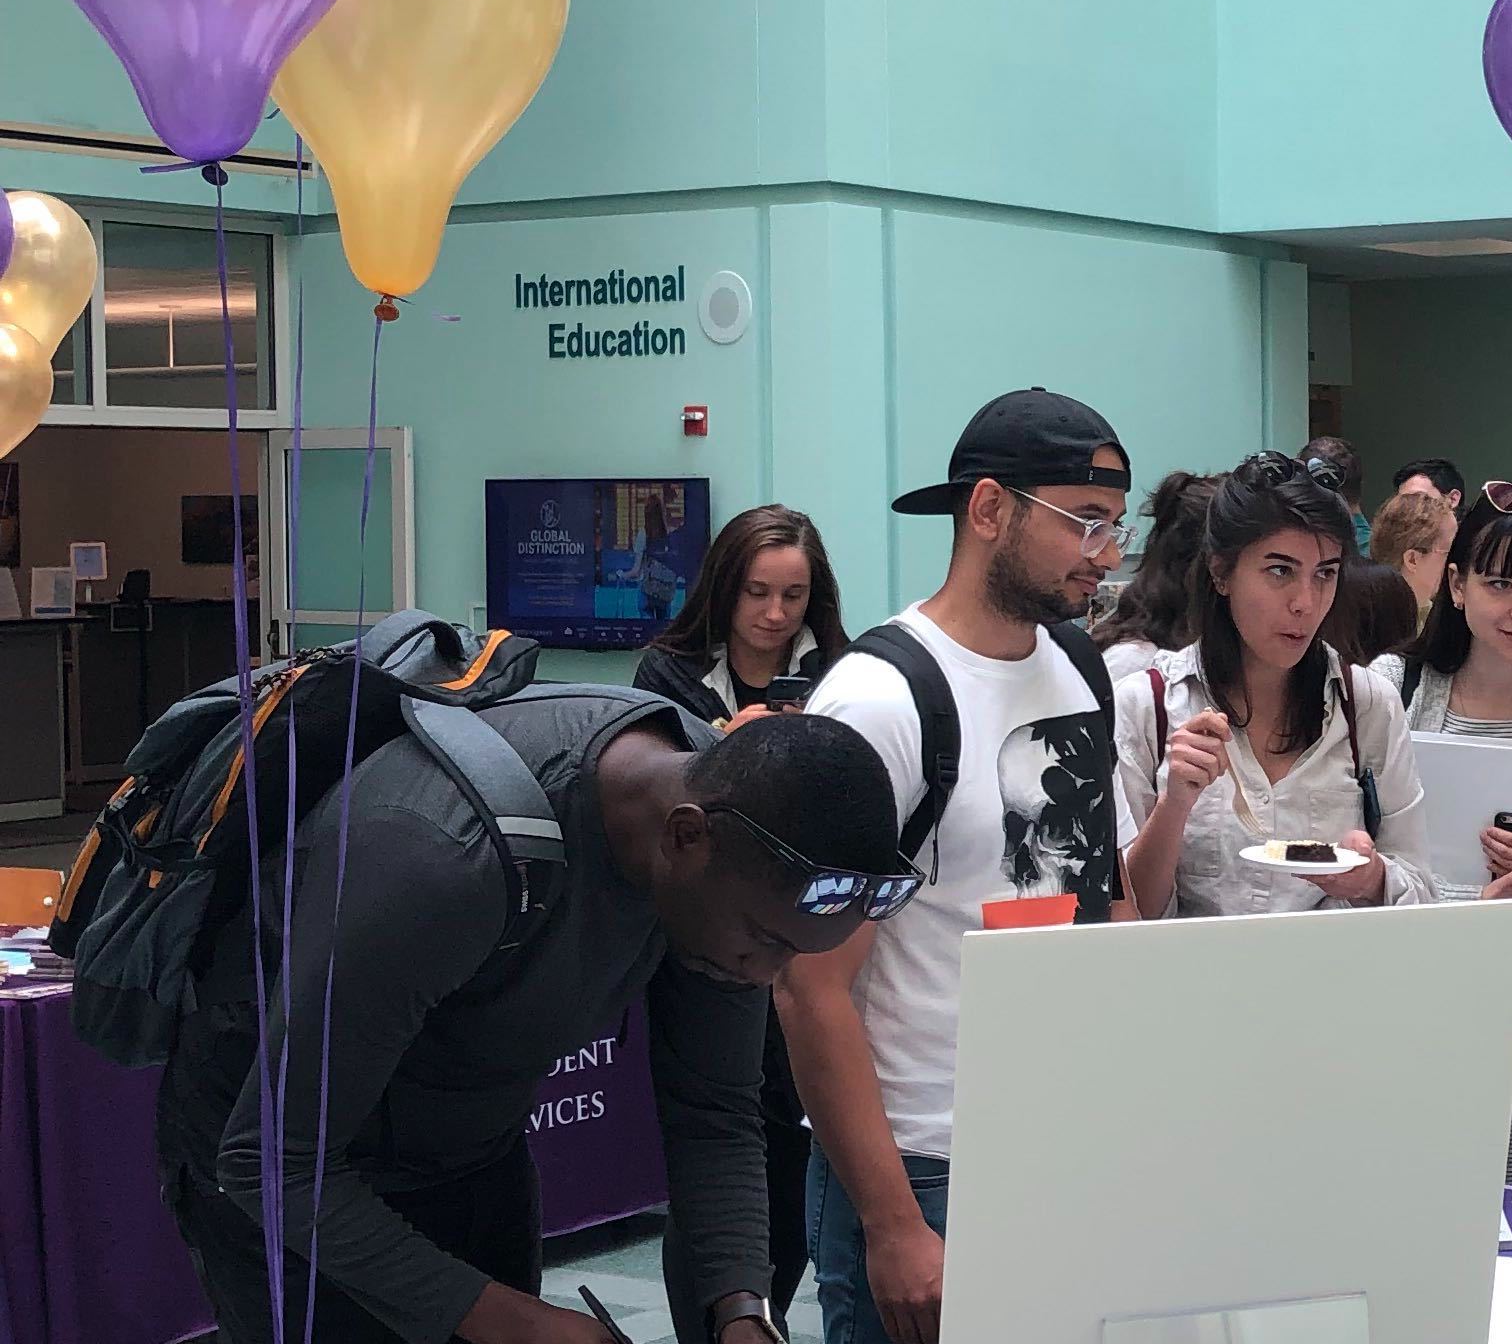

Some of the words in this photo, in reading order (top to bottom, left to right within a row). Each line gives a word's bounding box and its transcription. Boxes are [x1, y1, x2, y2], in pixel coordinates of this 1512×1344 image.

[514, 264, 685, 308] International
[548, 320, 686, 358] Education
[530, 529, 571, 542] GLOBAL
[517, 542, 585, 555] DISTINCTION
